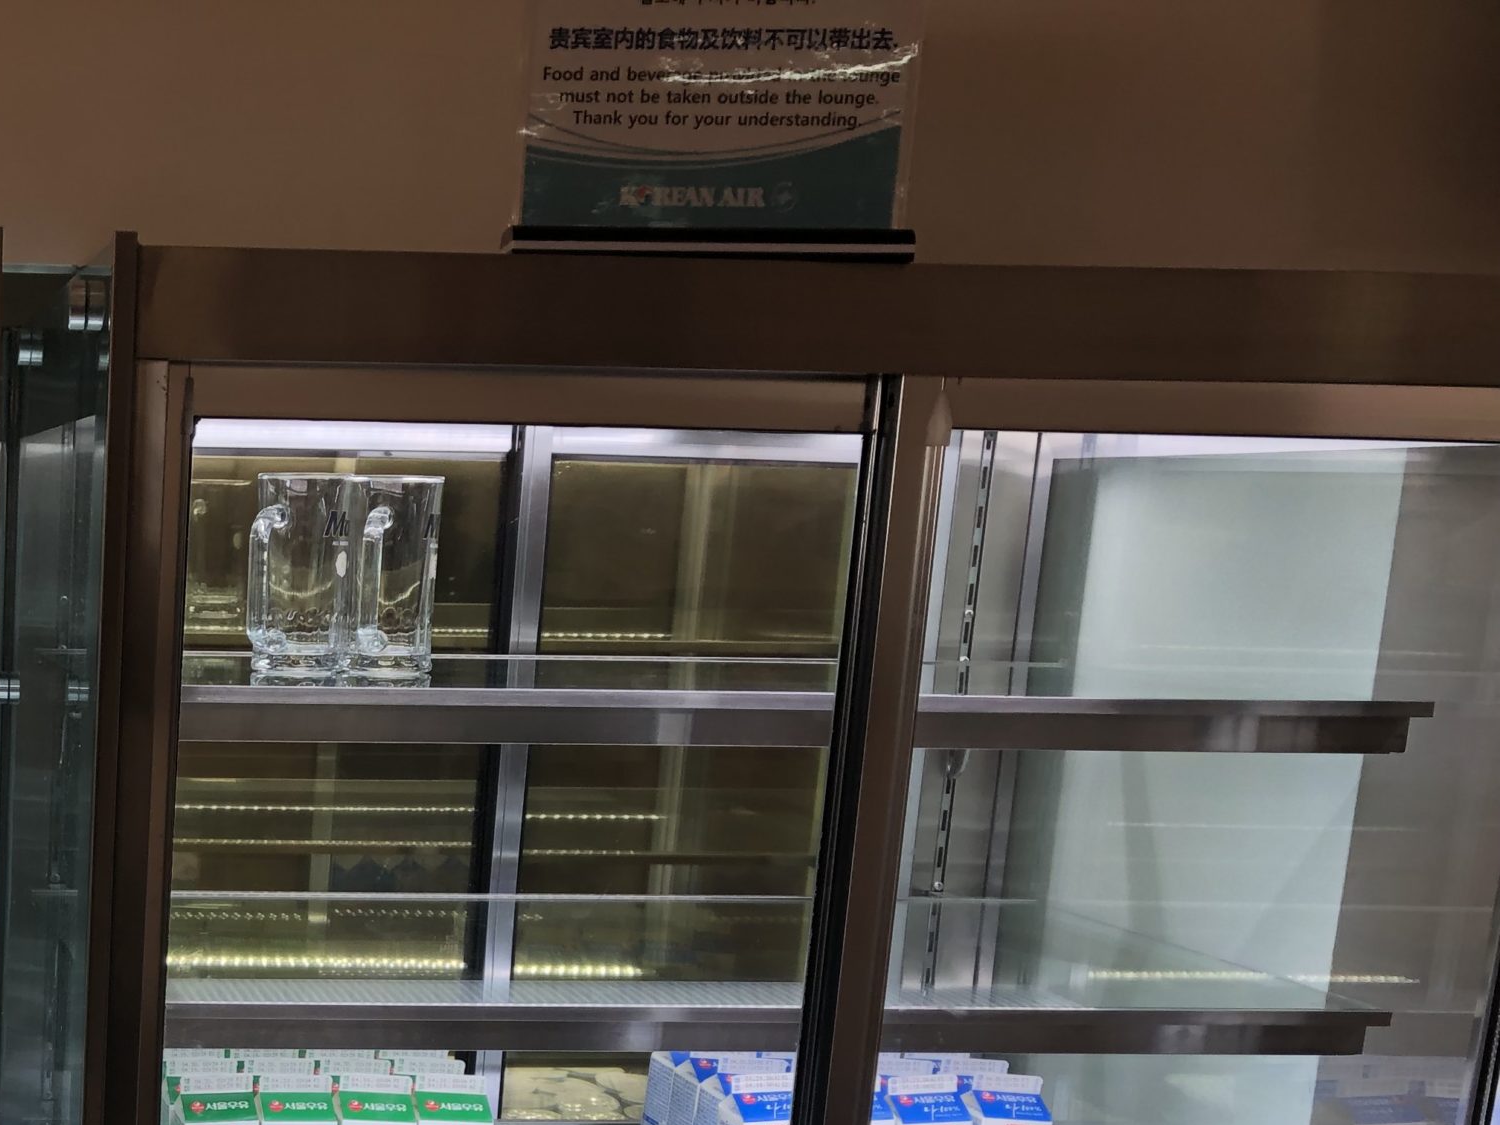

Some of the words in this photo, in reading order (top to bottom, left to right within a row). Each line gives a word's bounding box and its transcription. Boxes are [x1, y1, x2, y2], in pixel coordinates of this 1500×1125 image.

[543, 67, 583, 82] Food
[590, 67, 620, 82] and
[559, 91, 600, 105] must
[606, 91, 634, 105] not
[640, 90, 659, 104] be
[666, 90, 711, 104] taken
[717, 90, 779, 105] outside
[786, 90, 811, 105] the
[818, 90, 879, 107] lounge.
[573, 110, 622, 125] Thank
[628, 114, 658, 129] you
[664, 111, 689, 126] for
[694, 115, 732, 130] your
[738, 112, 863, 130] understanding.
[619, 184, 715, 208] KOREAN
[717, 186, 766, 208] AIR
[756, 1094, 792, 1103] 서울우
